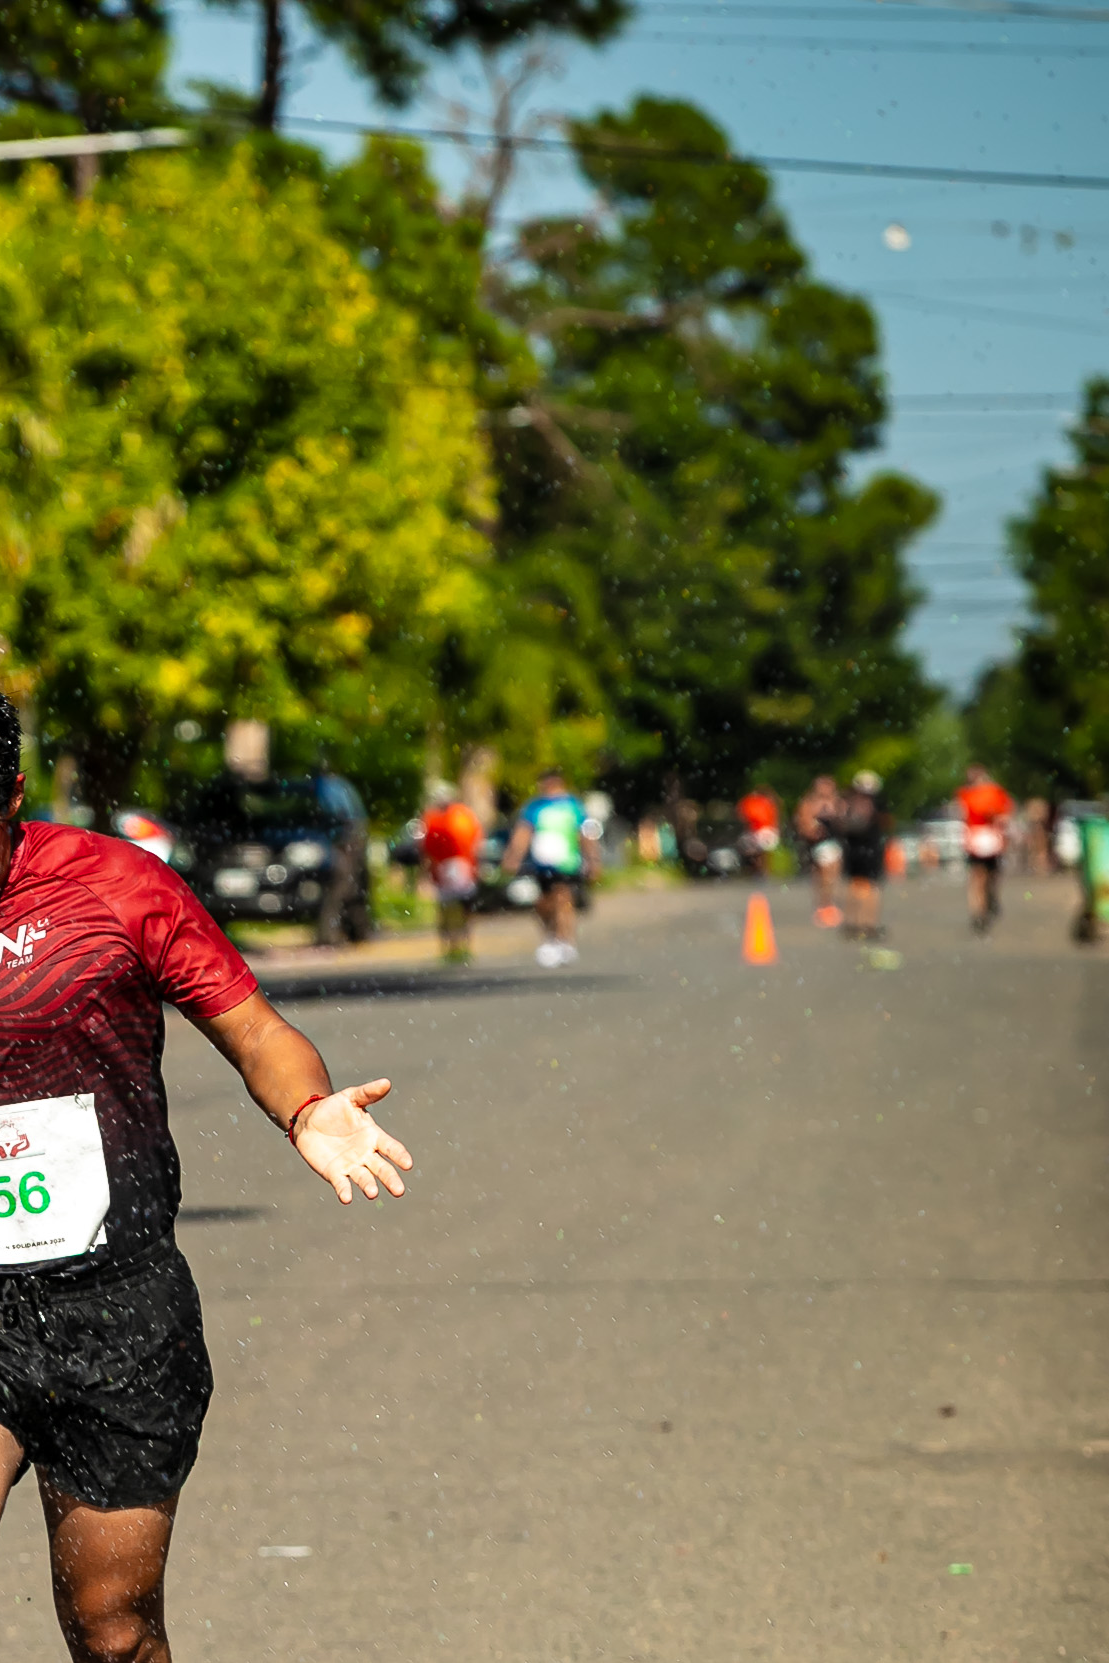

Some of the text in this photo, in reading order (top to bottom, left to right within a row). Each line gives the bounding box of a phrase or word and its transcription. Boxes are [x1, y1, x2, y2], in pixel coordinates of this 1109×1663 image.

[7, 955, 33, 969] TEAM
[12, 1240, 49, 1250] SOLIDARIA
[49, 1237, 66, 1245] 2025
